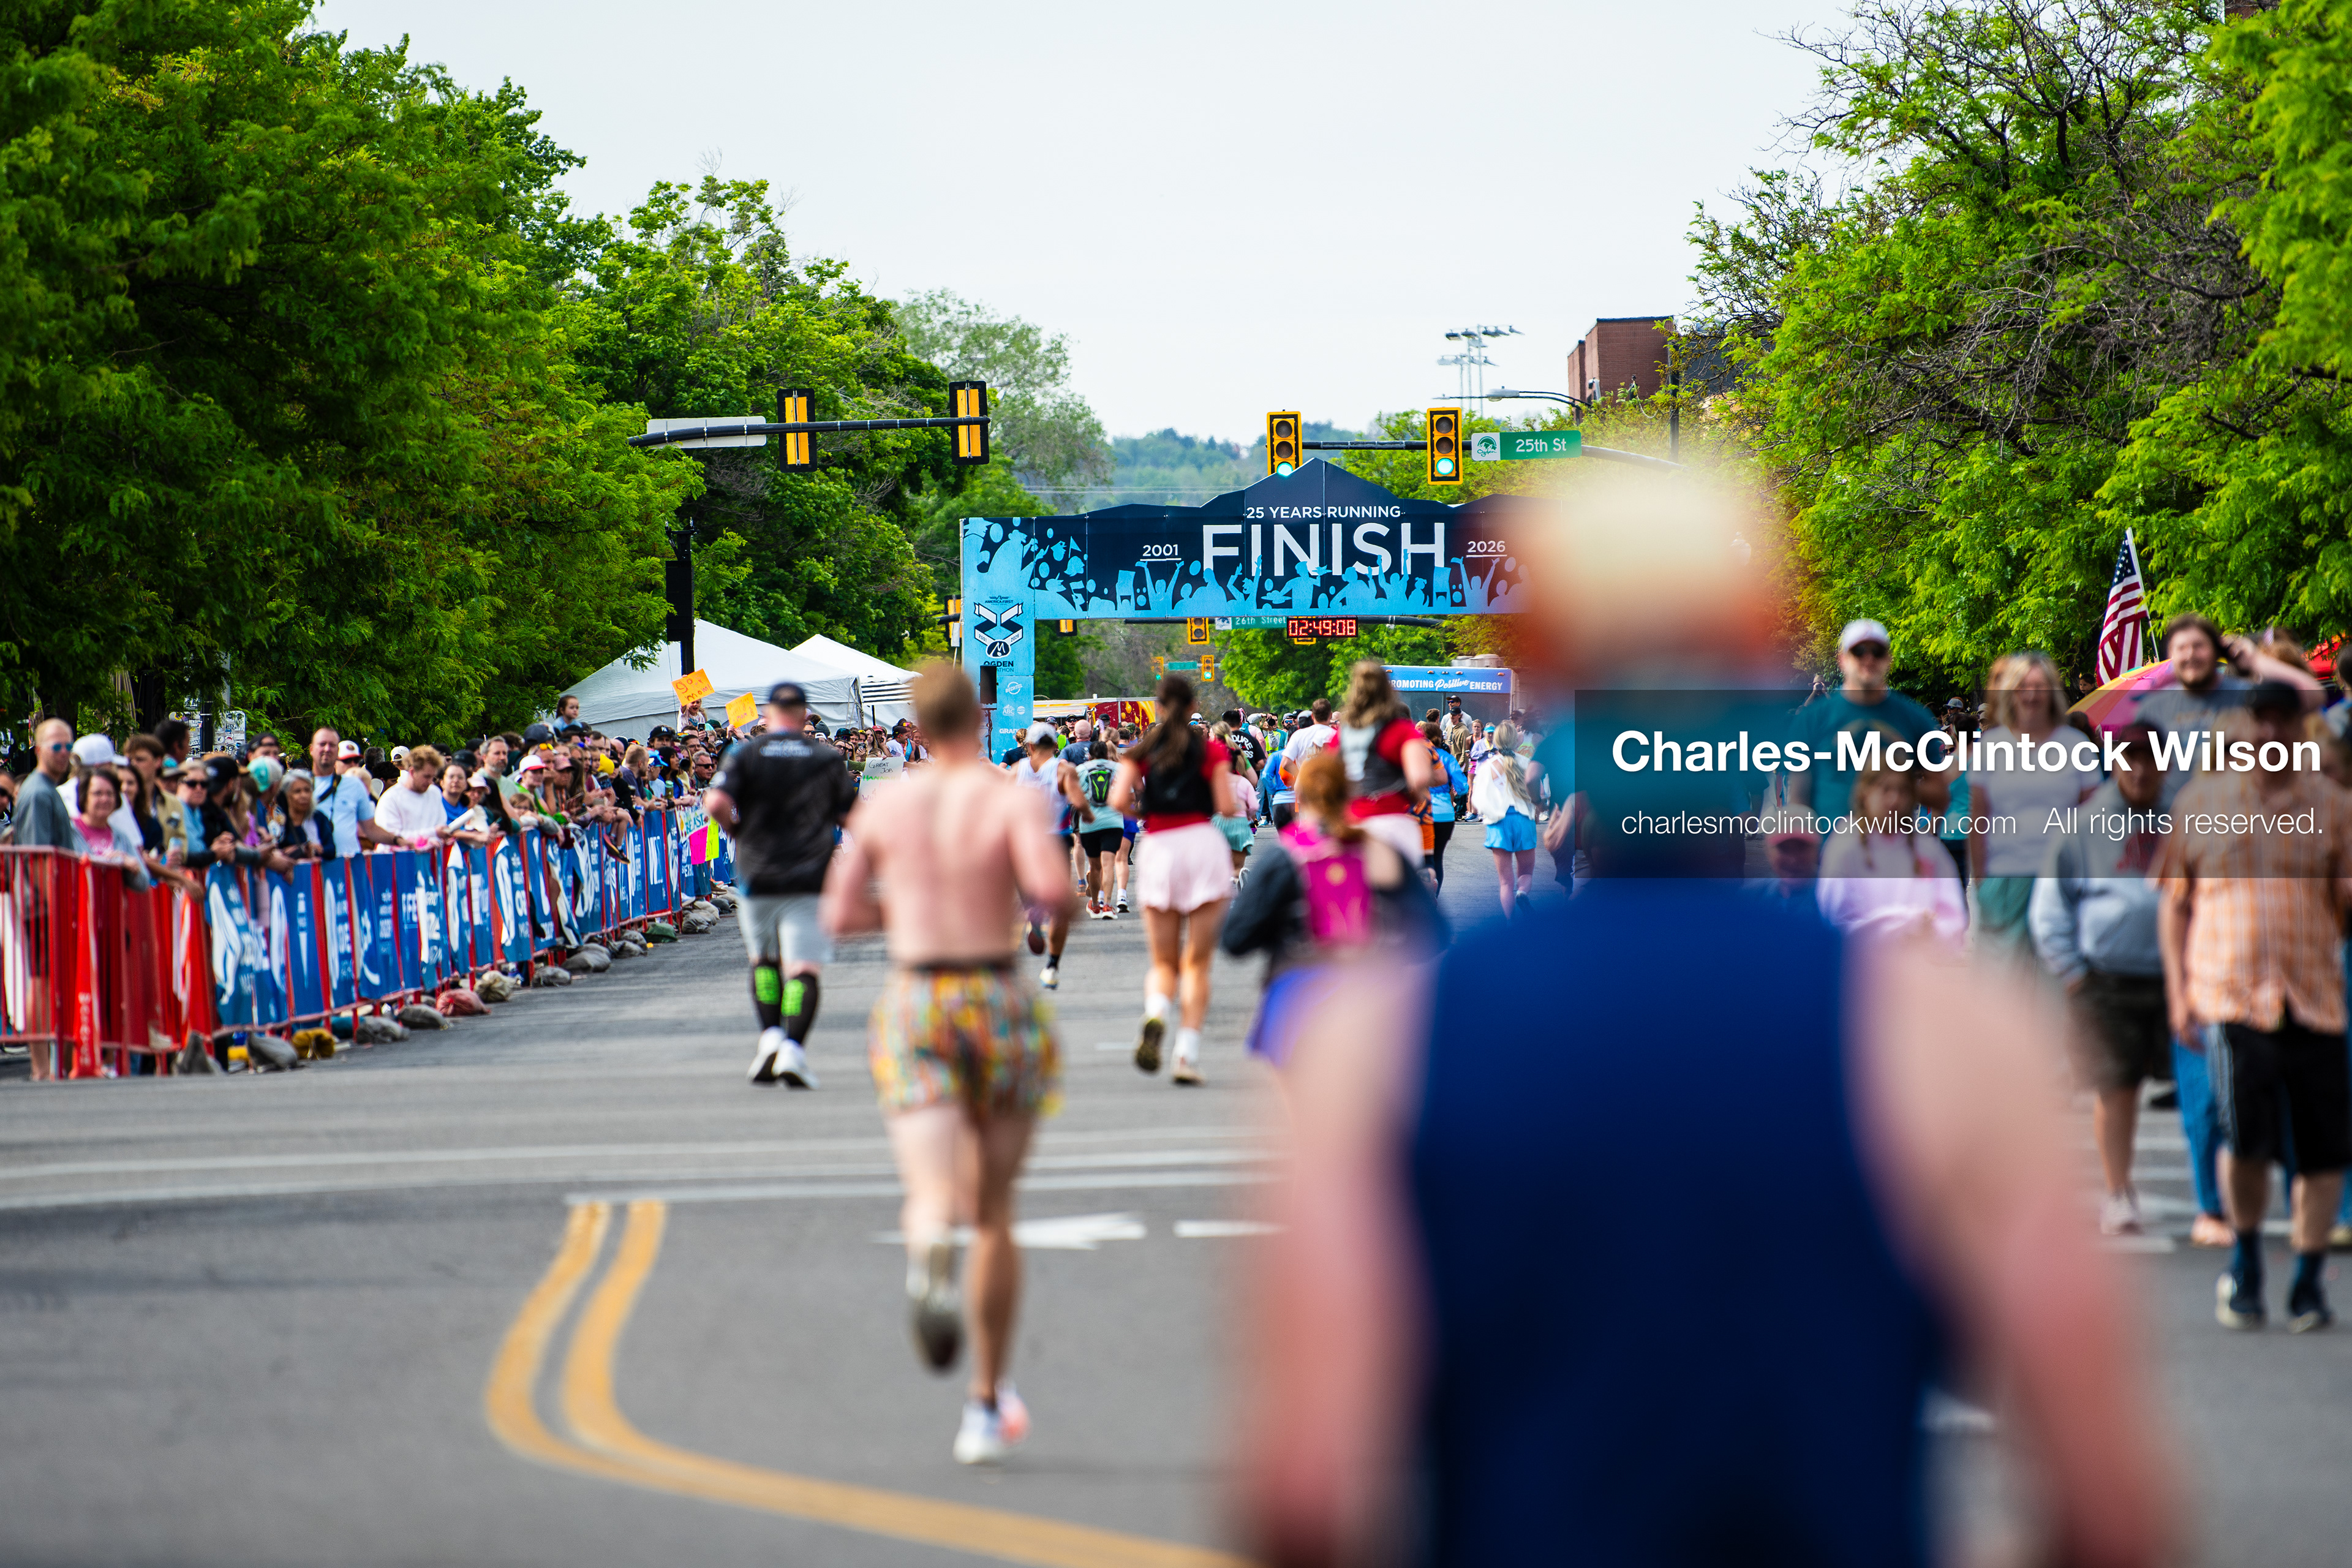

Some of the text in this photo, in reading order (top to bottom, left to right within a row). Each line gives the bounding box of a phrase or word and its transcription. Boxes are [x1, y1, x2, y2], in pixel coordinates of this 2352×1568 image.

[1515, 438, 1567, 453] 25th St
[1246, 505, 1401, 519] 25 YEARS RUNNING
[1142, 543, 1178, 557] 2001
[1202, 522, 1446, 576] FINISH
[1468, 540, 1506, 552] 2026
[1235, 617, 1256, 625] 26th
[1288, 619, 1357, 636] 02:49:08
[1005, 683, 1023, 693] BECHTEL
[1434, 678, 1469, 691] Positive
[1469, 681, 1503, 691] ENERGY
[1231, 734, 1254, 751] DURE
